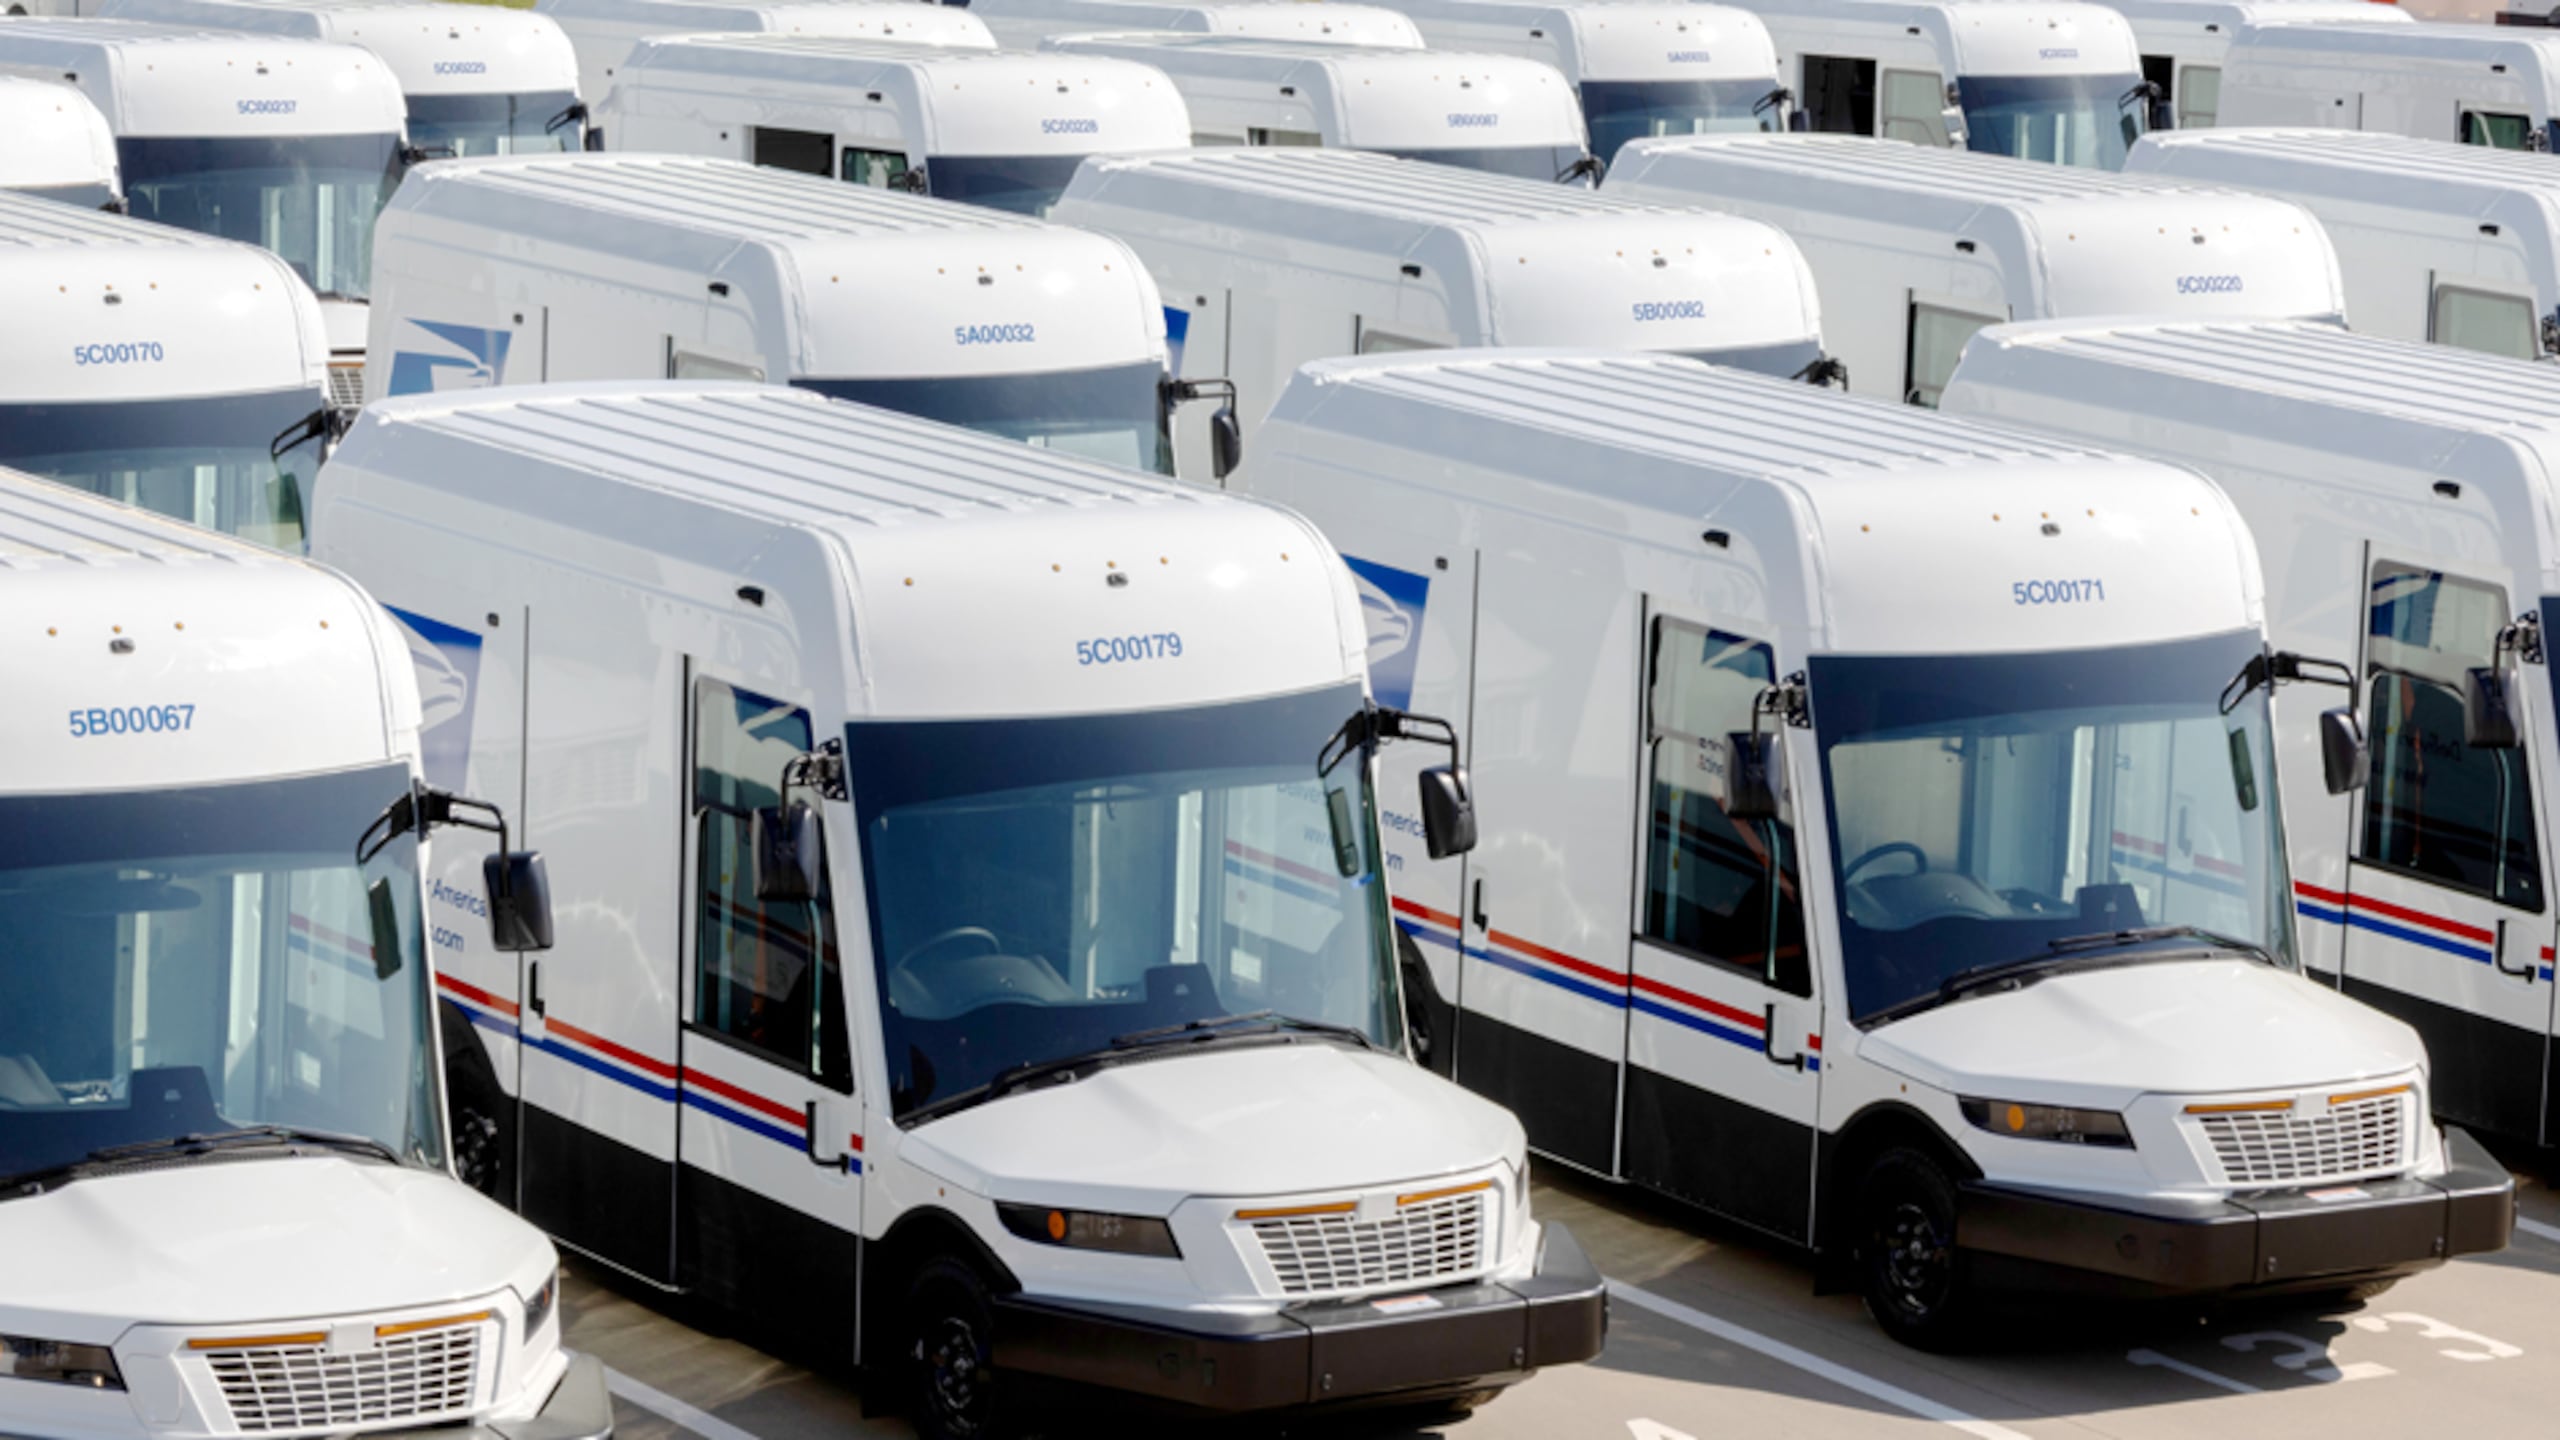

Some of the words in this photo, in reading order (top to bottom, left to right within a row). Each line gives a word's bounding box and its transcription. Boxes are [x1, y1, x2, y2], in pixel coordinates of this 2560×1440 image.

[2176, 275, 2243, 294] 5C00220
[1632, 301, 1706, 321] 5B00082
[954, 323, 1036, 346] 5A00032
[74, 342, 164, 366] 5C00170
[2012, 579, 2105, 605] 5C00171
[1076, 632, 1183, 666] 5C00179
[69, 703, 197, 738] 5B00067
[432, 878, 487, 917] America
[429, 924, 465, 953] .com
